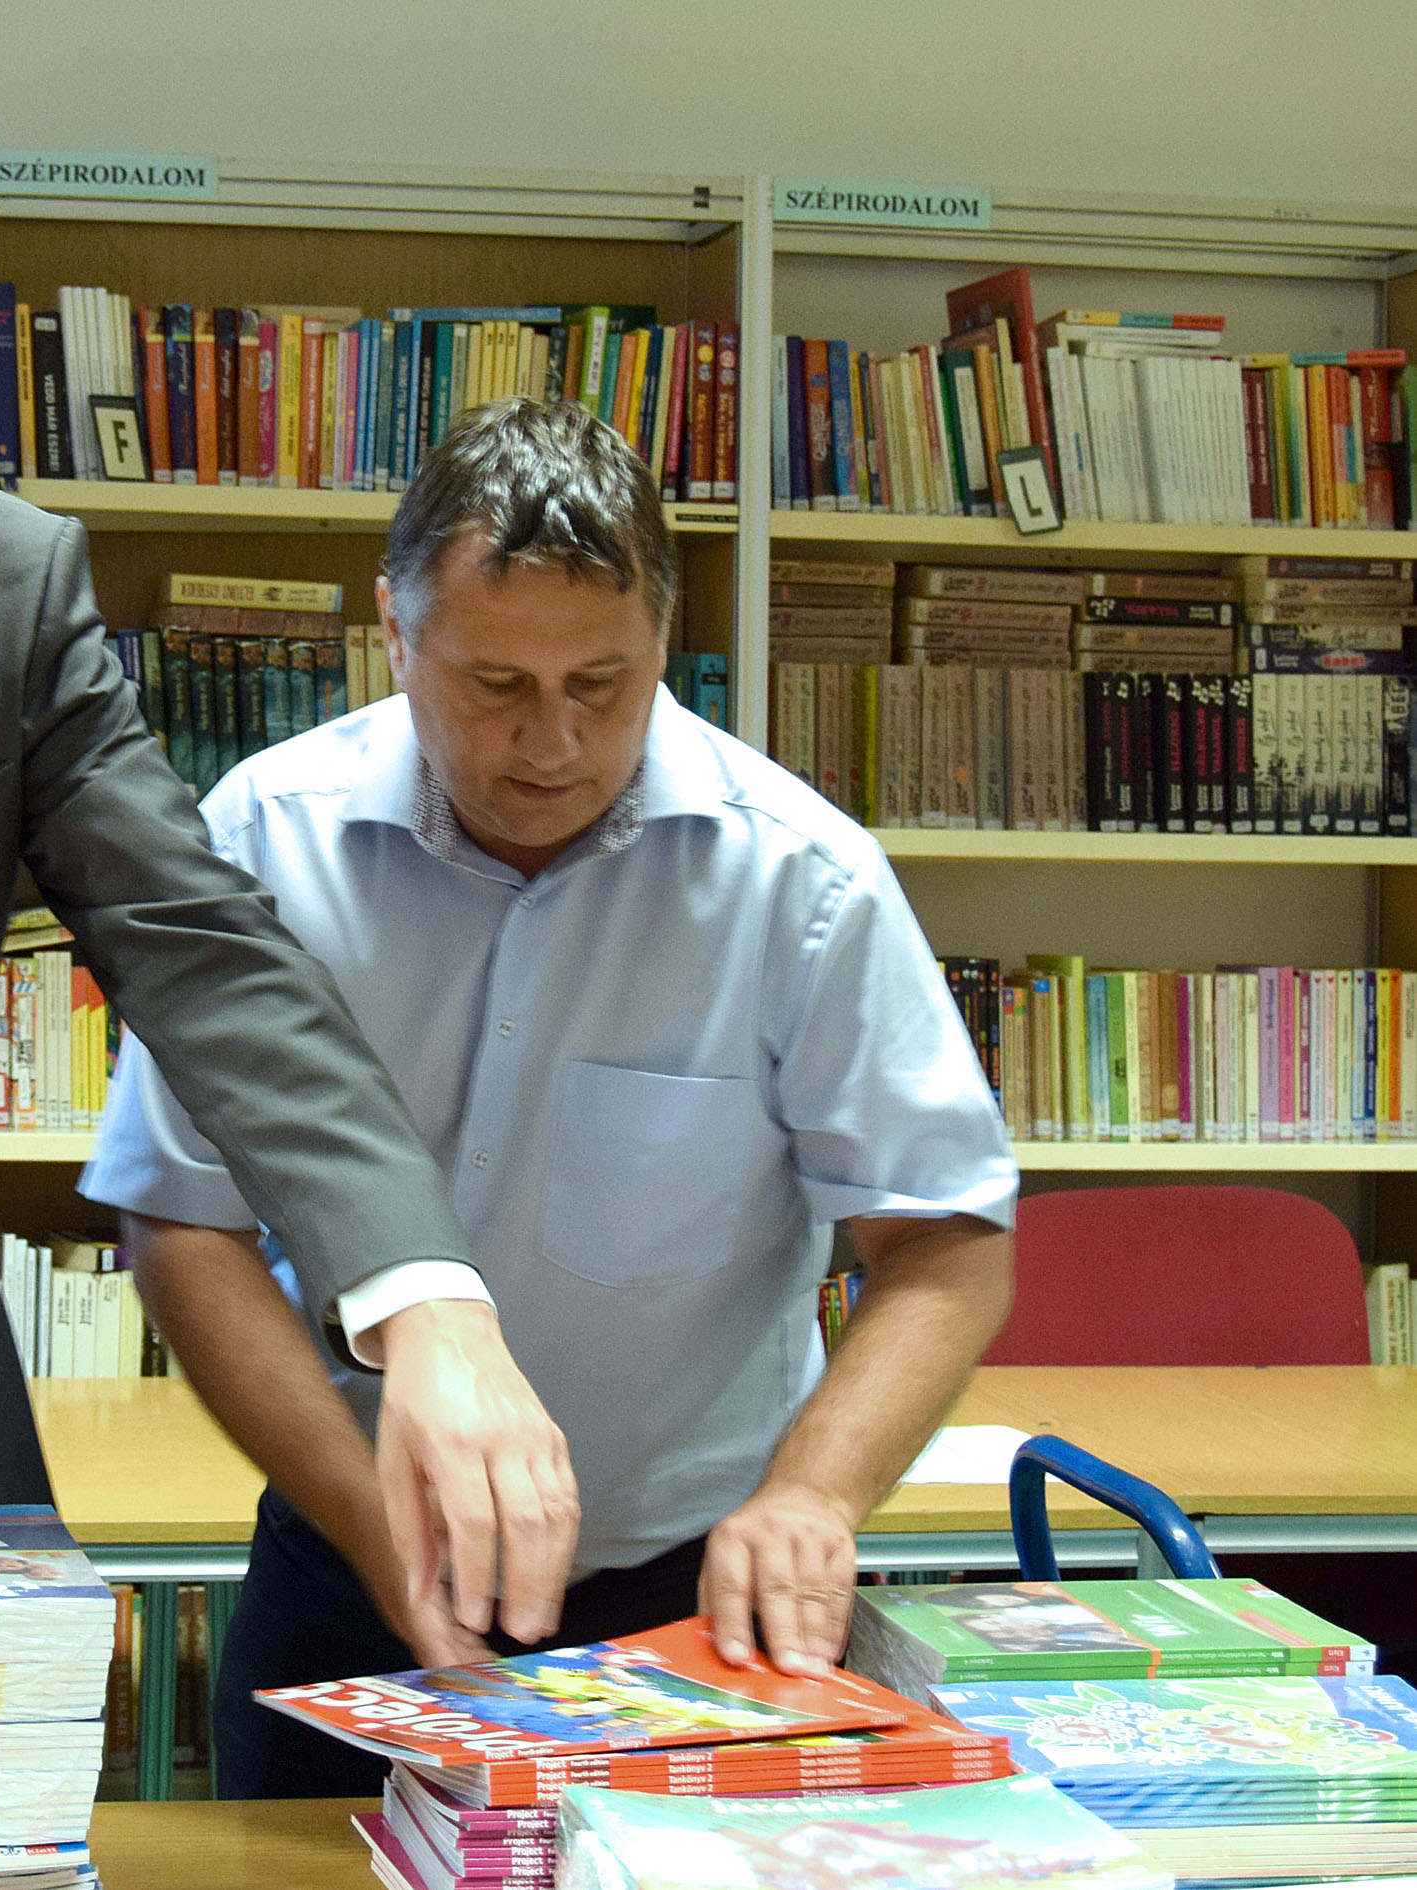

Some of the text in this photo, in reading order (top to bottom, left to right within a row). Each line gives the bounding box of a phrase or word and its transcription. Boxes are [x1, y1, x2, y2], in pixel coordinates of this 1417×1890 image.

[785, 185, 980, 219] SZÉPIRODALOM
[111, 419, 130, 464] F
[1018, 475, 1044, 518] L
[485, 1750, 515, 1760] Project
[536, 1760, 567, 1770] Project
[667, 1753, 706, 1763] Tankönyv
[536, 1771, 567, 1781] Project
[570, 1770, 589, 1778] Fourth
[668, 1764, 706, 1774] Tankönyv
[668, 1775, 706, 1785] Tankönyv
[669, 1784, 706, 1794] Tankönyv
[507, 1809, 539, 1819] Project
[517, 1820, 549, 1829] Project
[503, 1838, 535, 1846] Project
[27, 1847, 57, 1855] Klett
[511, 1847, 543, 1856] Project
[511, 1857, 544, 1866] Project
[512, 1867, 544, 1876] Project
